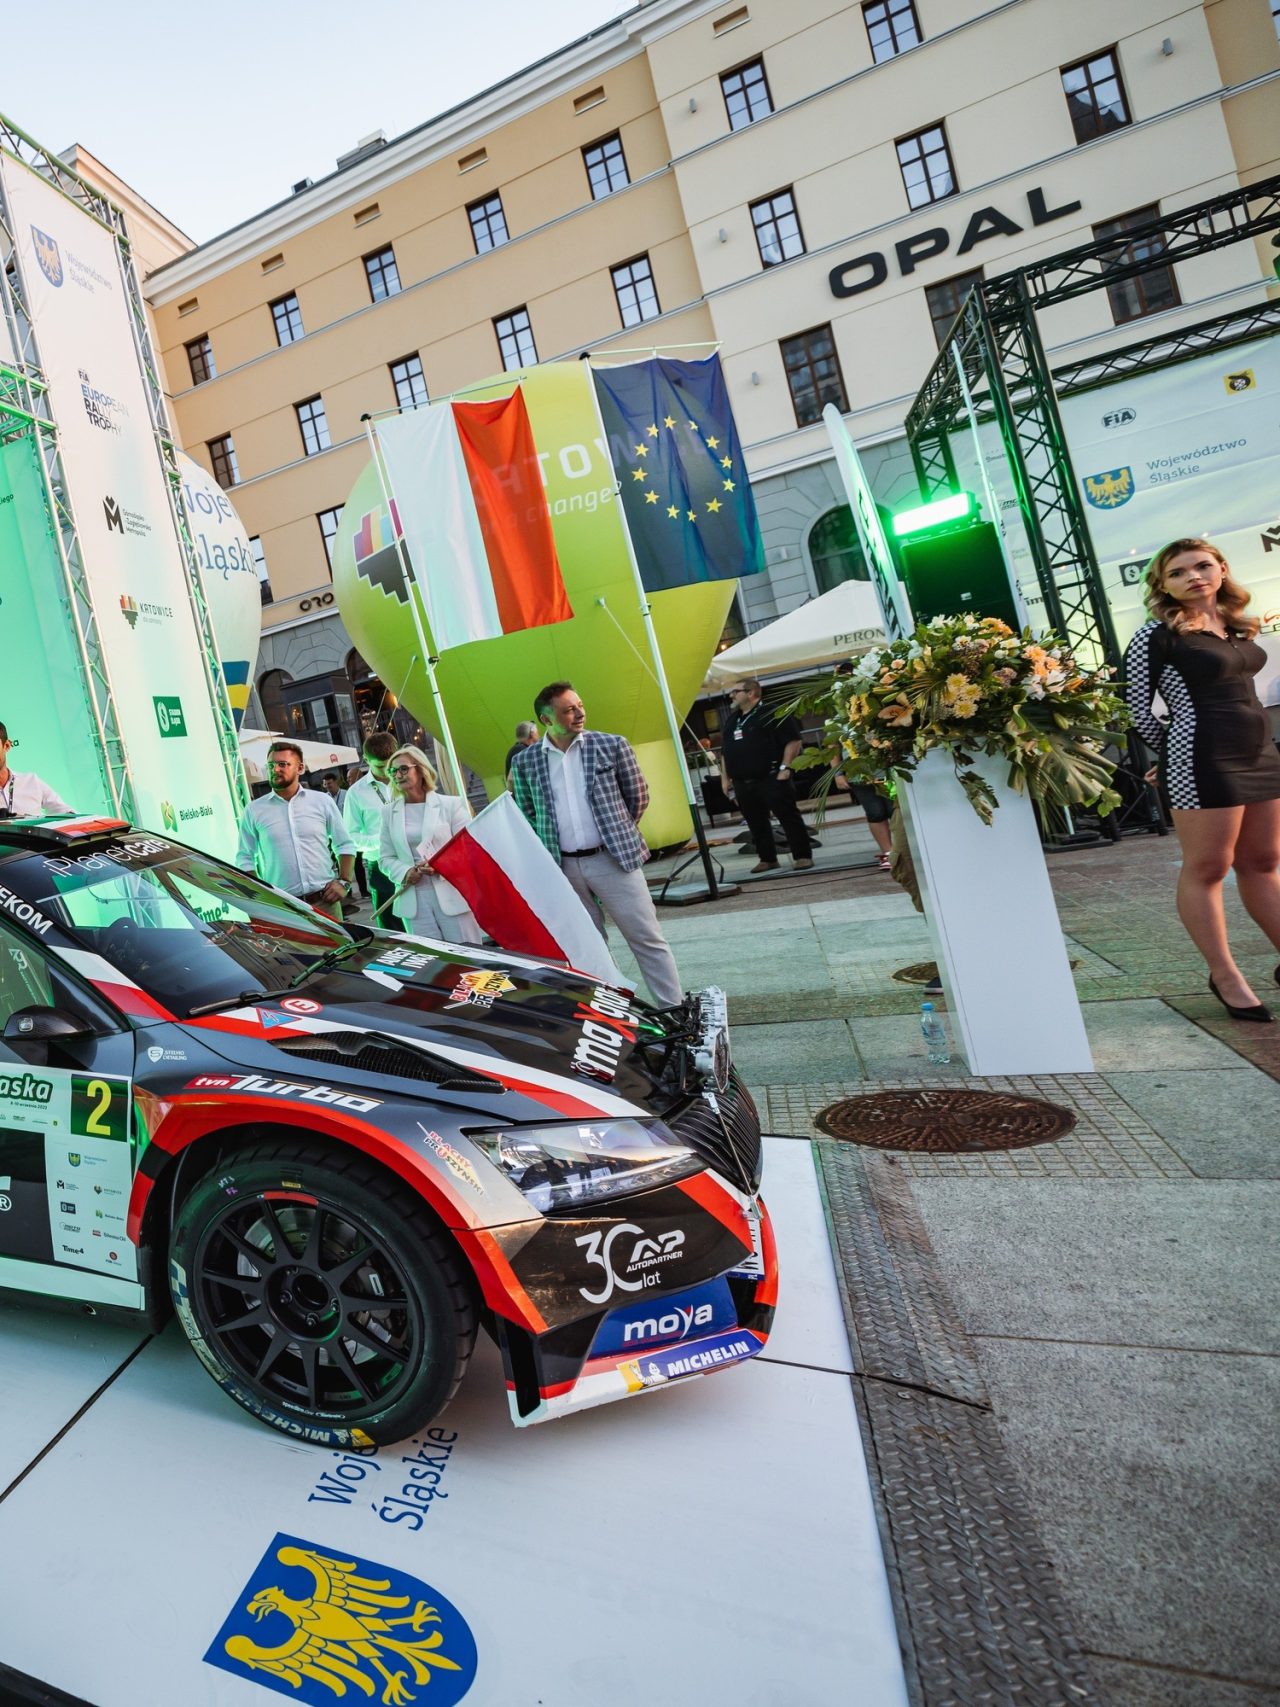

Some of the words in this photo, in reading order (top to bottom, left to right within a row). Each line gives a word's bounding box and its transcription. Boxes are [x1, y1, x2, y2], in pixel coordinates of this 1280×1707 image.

[828, 187, 1081, 299] OPAL
[80, 384, 130, 417] EUROPEAN
[1147, 437, 1247, 471] Województwo
[1150, 463, 1200, 484] Śląskie
[140, 603, 173, 618] KATOWICE
[180, 806, 213, 822] Bielsko-Biała
[194, 1076, 231, 1087] tvn
[85, 1079, 113, 1137] 2
[626, 1250, 684, 1273] AUTOPARTNER
[642, 1271, 662, 1288] lat
[624, 1302, 714, 1341] moya
[668, 1341, 750, 1378] MICHELIN
[371, 1427, 458, 1531] Śląskie
